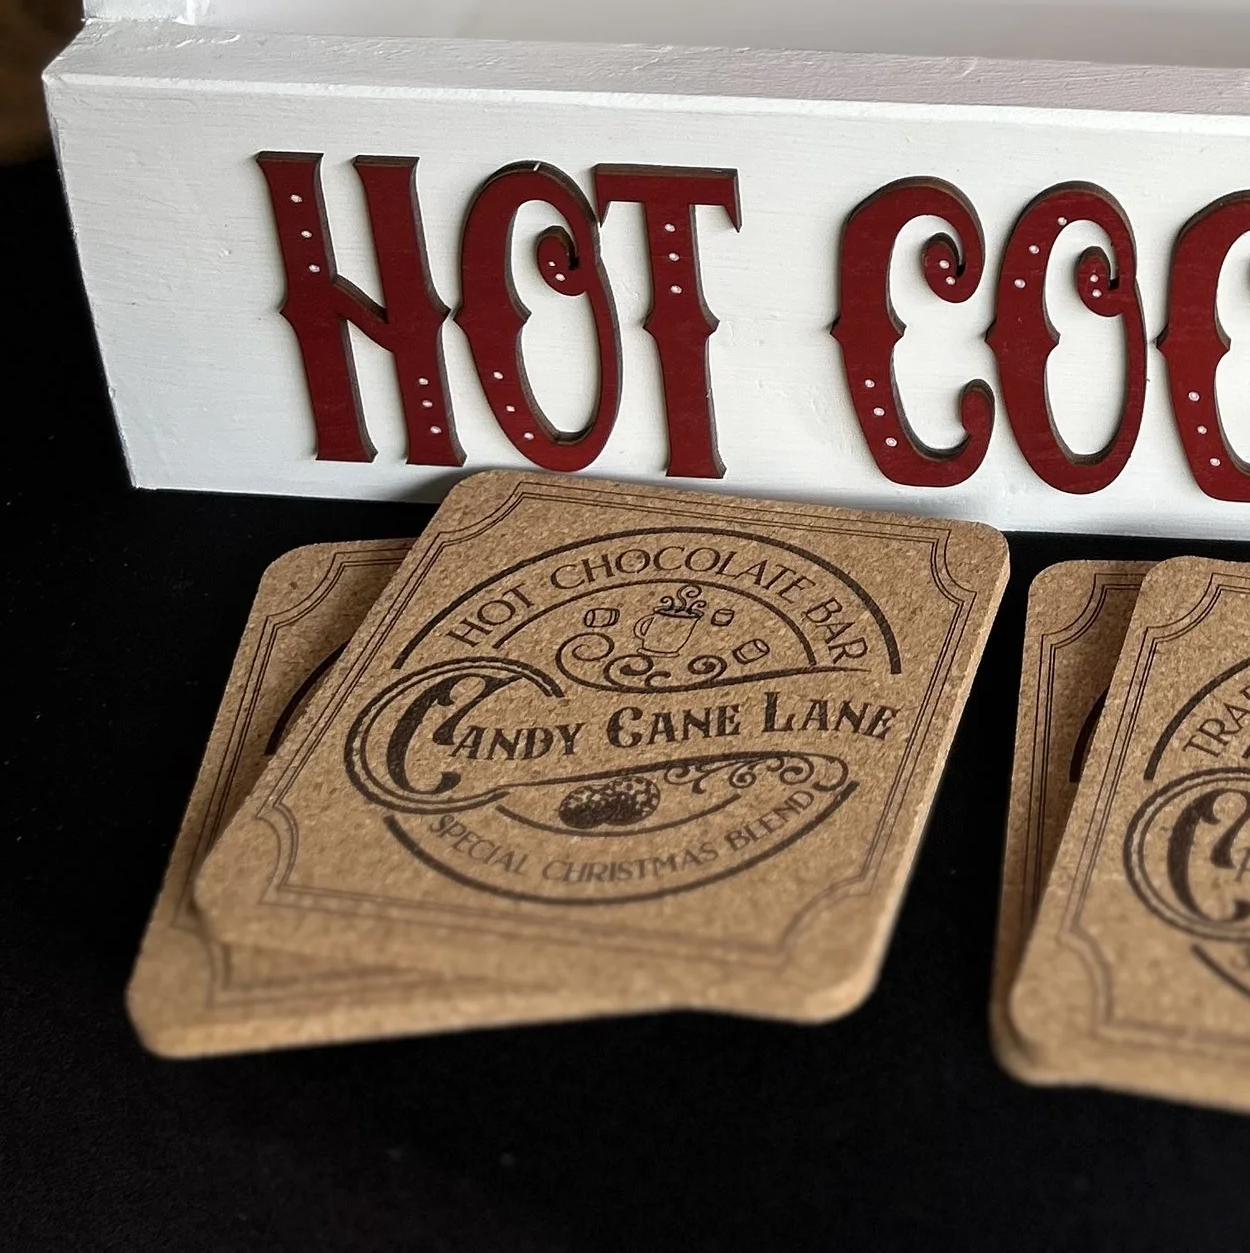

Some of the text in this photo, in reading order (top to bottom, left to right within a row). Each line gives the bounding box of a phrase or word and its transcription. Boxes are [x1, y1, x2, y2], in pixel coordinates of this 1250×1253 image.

[256, 151, 741, 480] HOT
[446, 545, 869, 664] HOT CHOCOLATE BAR
[428, 790, 816, 885] SPECIAL CHRISTMAS BLEND
